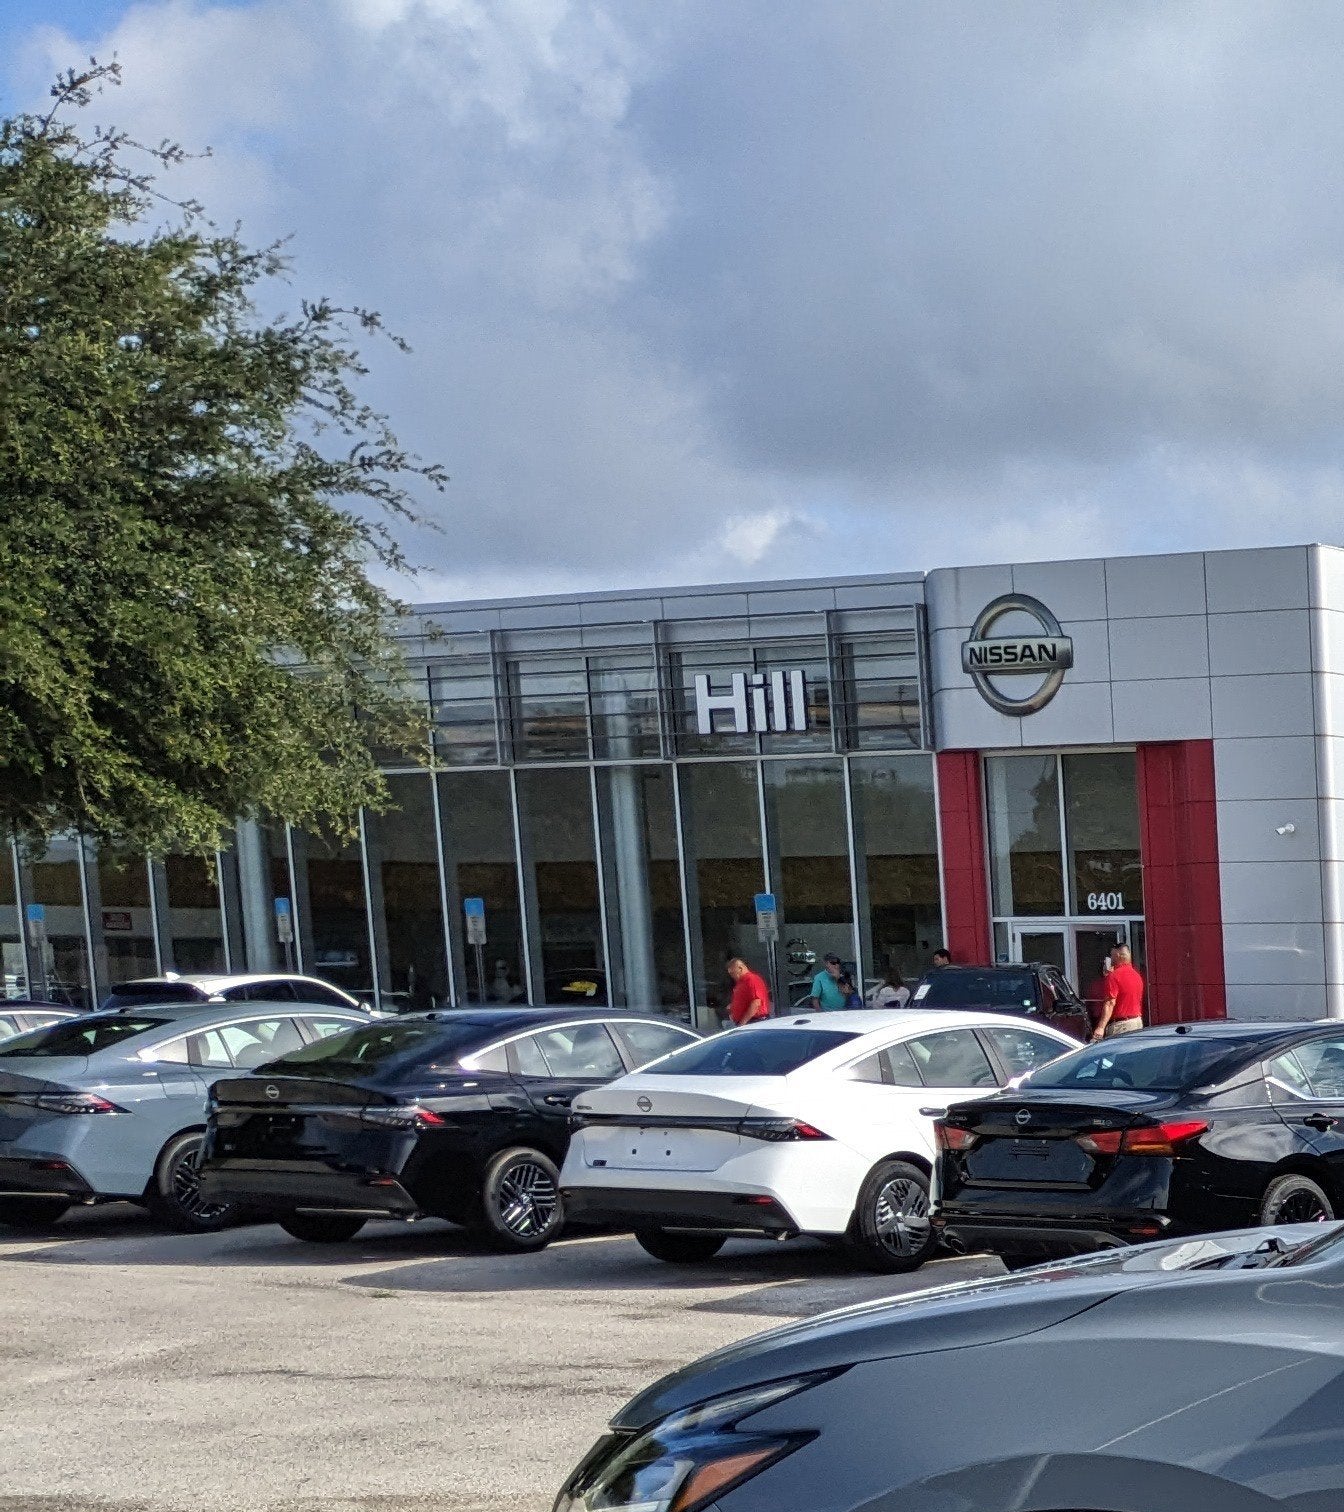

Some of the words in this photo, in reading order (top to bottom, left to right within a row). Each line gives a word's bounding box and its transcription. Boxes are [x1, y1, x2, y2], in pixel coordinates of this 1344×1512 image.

[969, 643, 1057, 665] NISSAN
[695, 670, 807, 735] Hill
[1087, 892, 1125, 910] 6401
